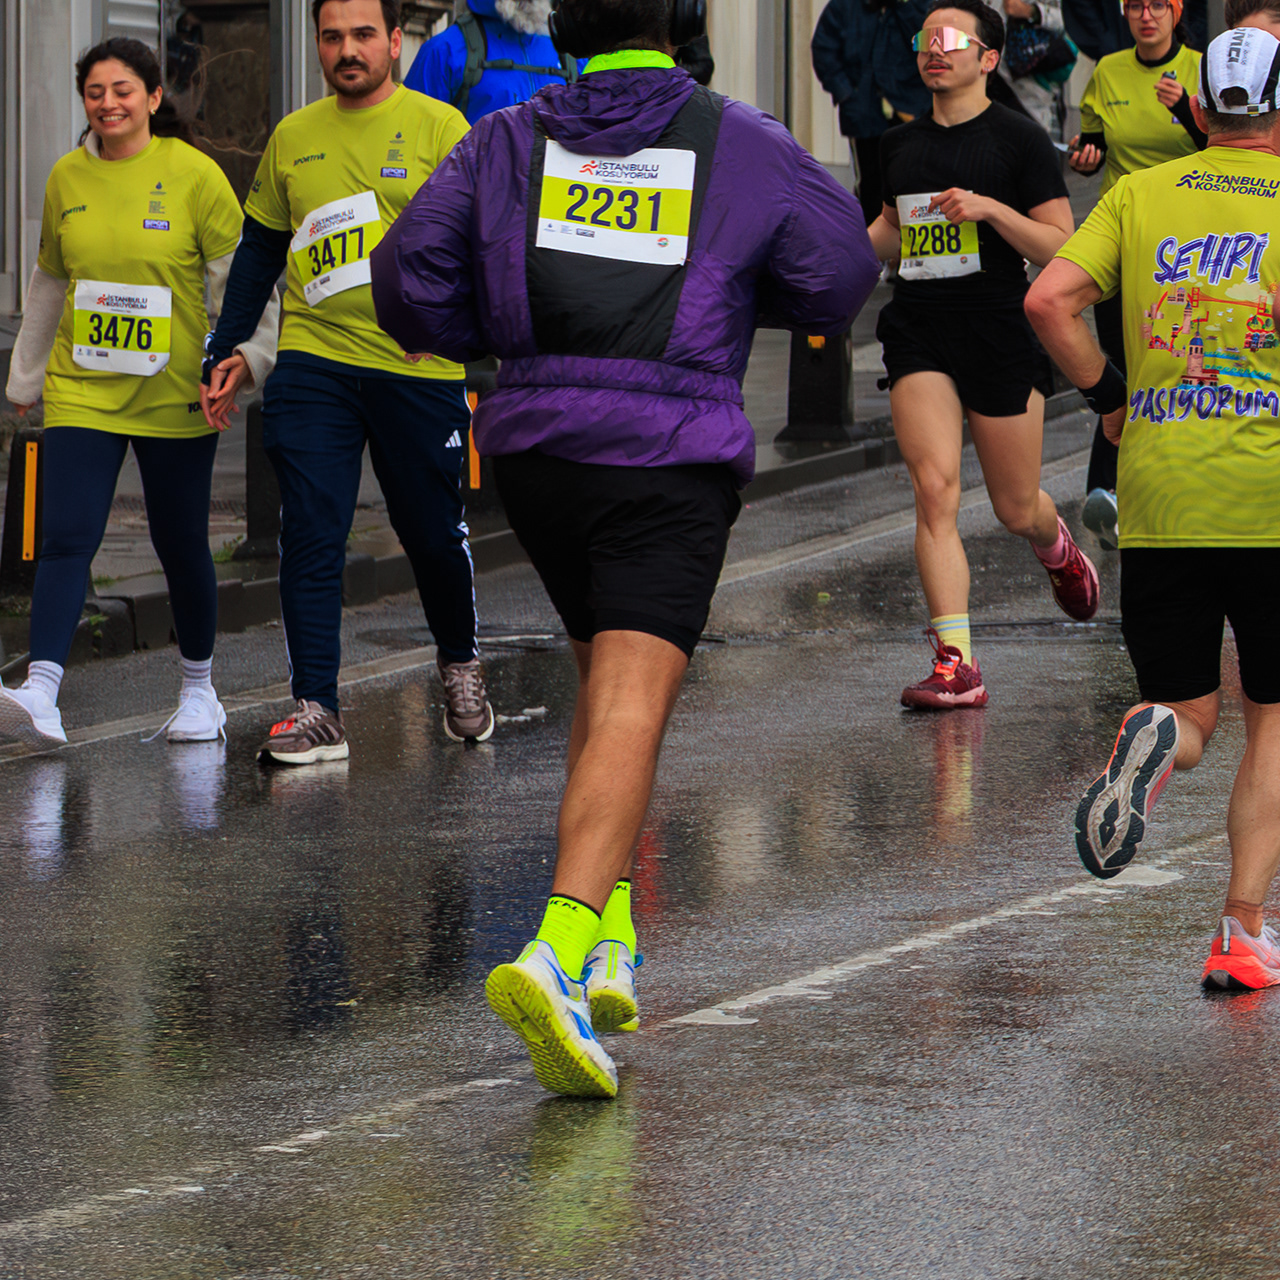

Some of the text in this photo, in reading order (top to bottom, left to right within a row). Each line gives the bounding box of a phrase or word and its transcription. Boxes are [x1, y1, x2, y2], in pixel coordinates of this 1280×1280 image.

[599, 160, 660, 172] İSTANBULU
[1199, 170, 1280, 190] İSTANBULU
[565, 183, 663, 232] 2231
[308, 226, 364, 277] 3477
[908, 223, 962, 257] 2288
[88, 313, 153, 351] 3476
[1129, 384, 1280, 425] YAŞIYORUM
